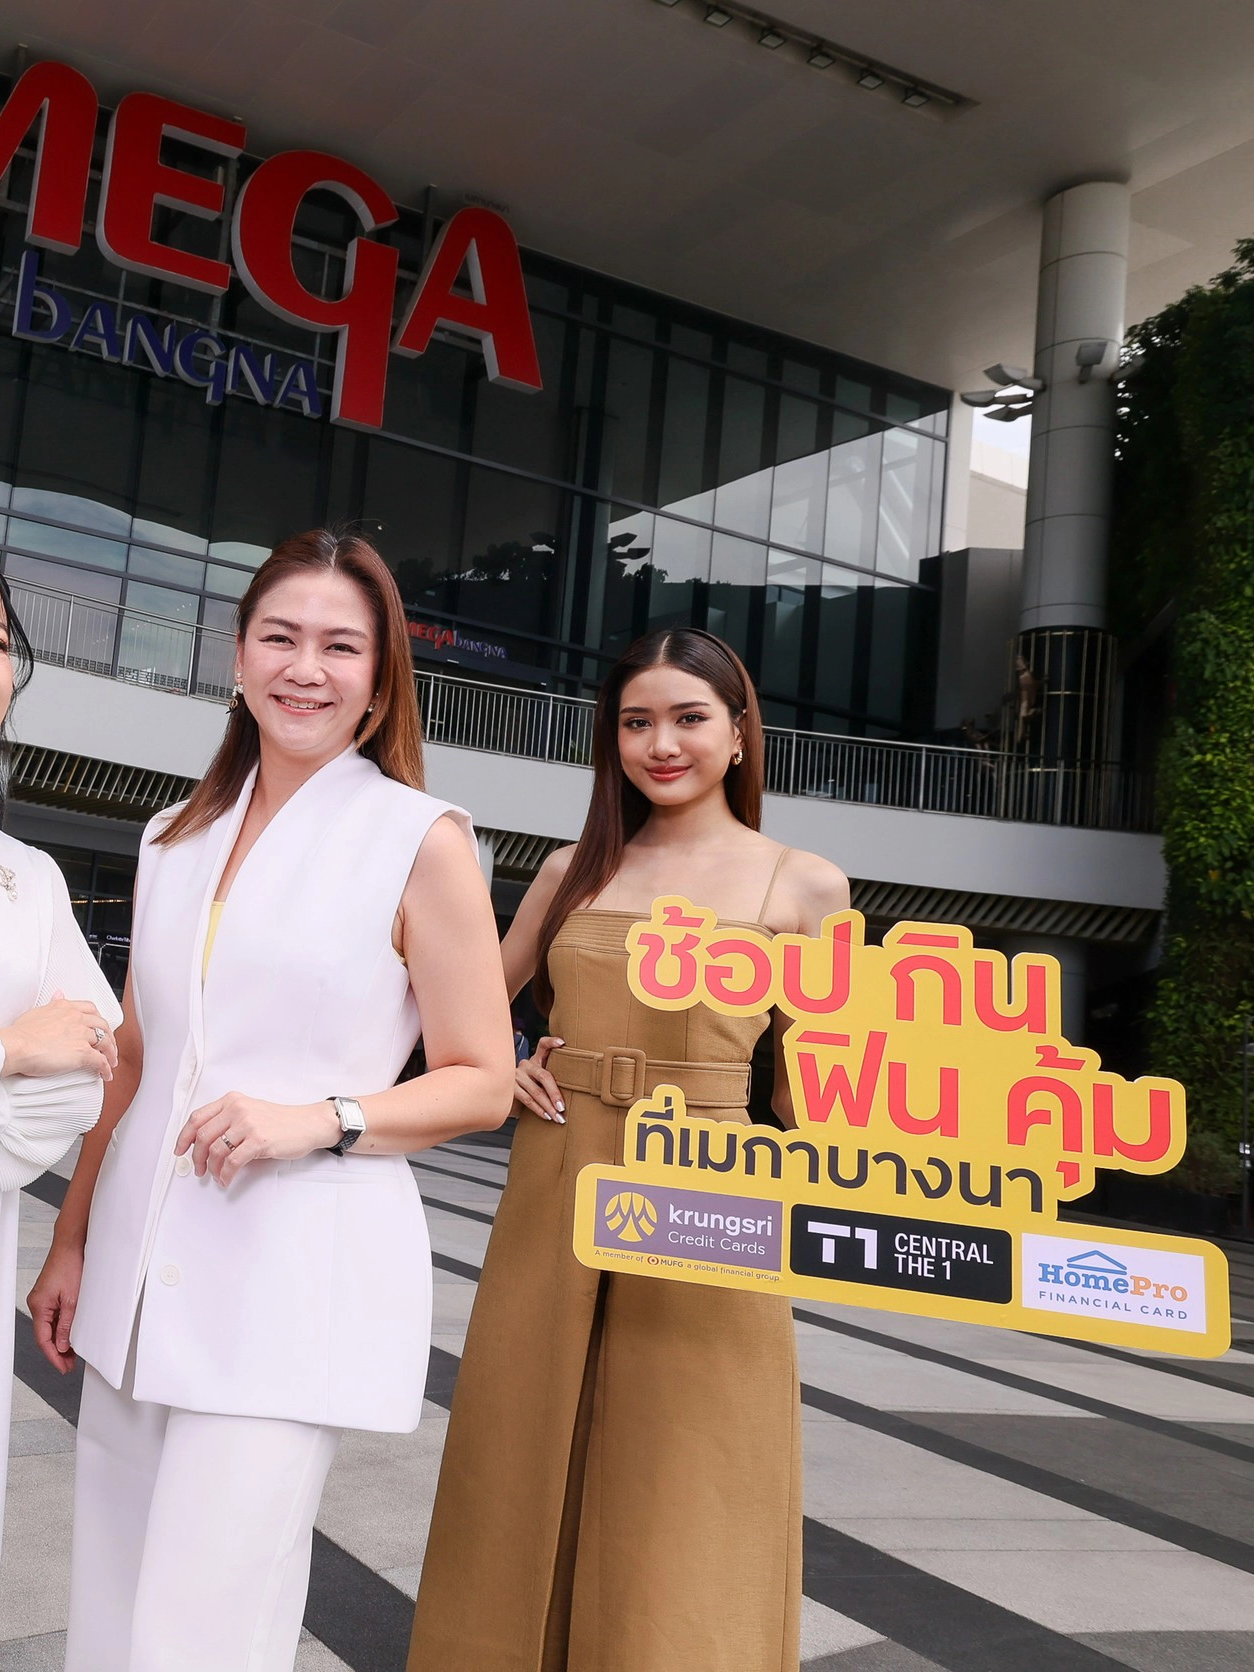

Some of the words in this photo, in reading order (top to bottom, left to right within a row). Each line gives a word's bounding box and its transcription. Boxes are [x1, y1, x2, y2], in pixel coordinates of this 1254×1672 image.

[637, 906, 852, 1014] ช้อป
[890, 932, 1049, 1034] กิน
[795, 1030, 960, 1138] ฟิน
[1007, 1044, 1171, 1189] คุ้ม
[635, 1096, 1043, 1213] ที่เมกาบางนา
[669, 1203, 773, 1237] krungsri
[668, 1230, 715, 1249] Credit
[720, 1238, 766, 1255] Cards
[807, 1221, 878, 1270] T1
[894, 1232, 994, 1265] CENTRAL
[603, 1251, 634, 1261] member
[635, 1255, 644, 1264] of
[660, 1258, 684, 1268] MUFG
[694, 1262, 719, 1273] global
[720, 1266, 754, 1278] financial
[756, 1273, 780, 1282] group
[894, 1253, 935, 1278] THE
[942, 1260, 951, 1280] 1
[1038, 1262, 1188, 1302] HomePro
[1039, 1290, 1132, 1312] FINANCIAL
[1140, 1305, 1188, 1320] CARD
